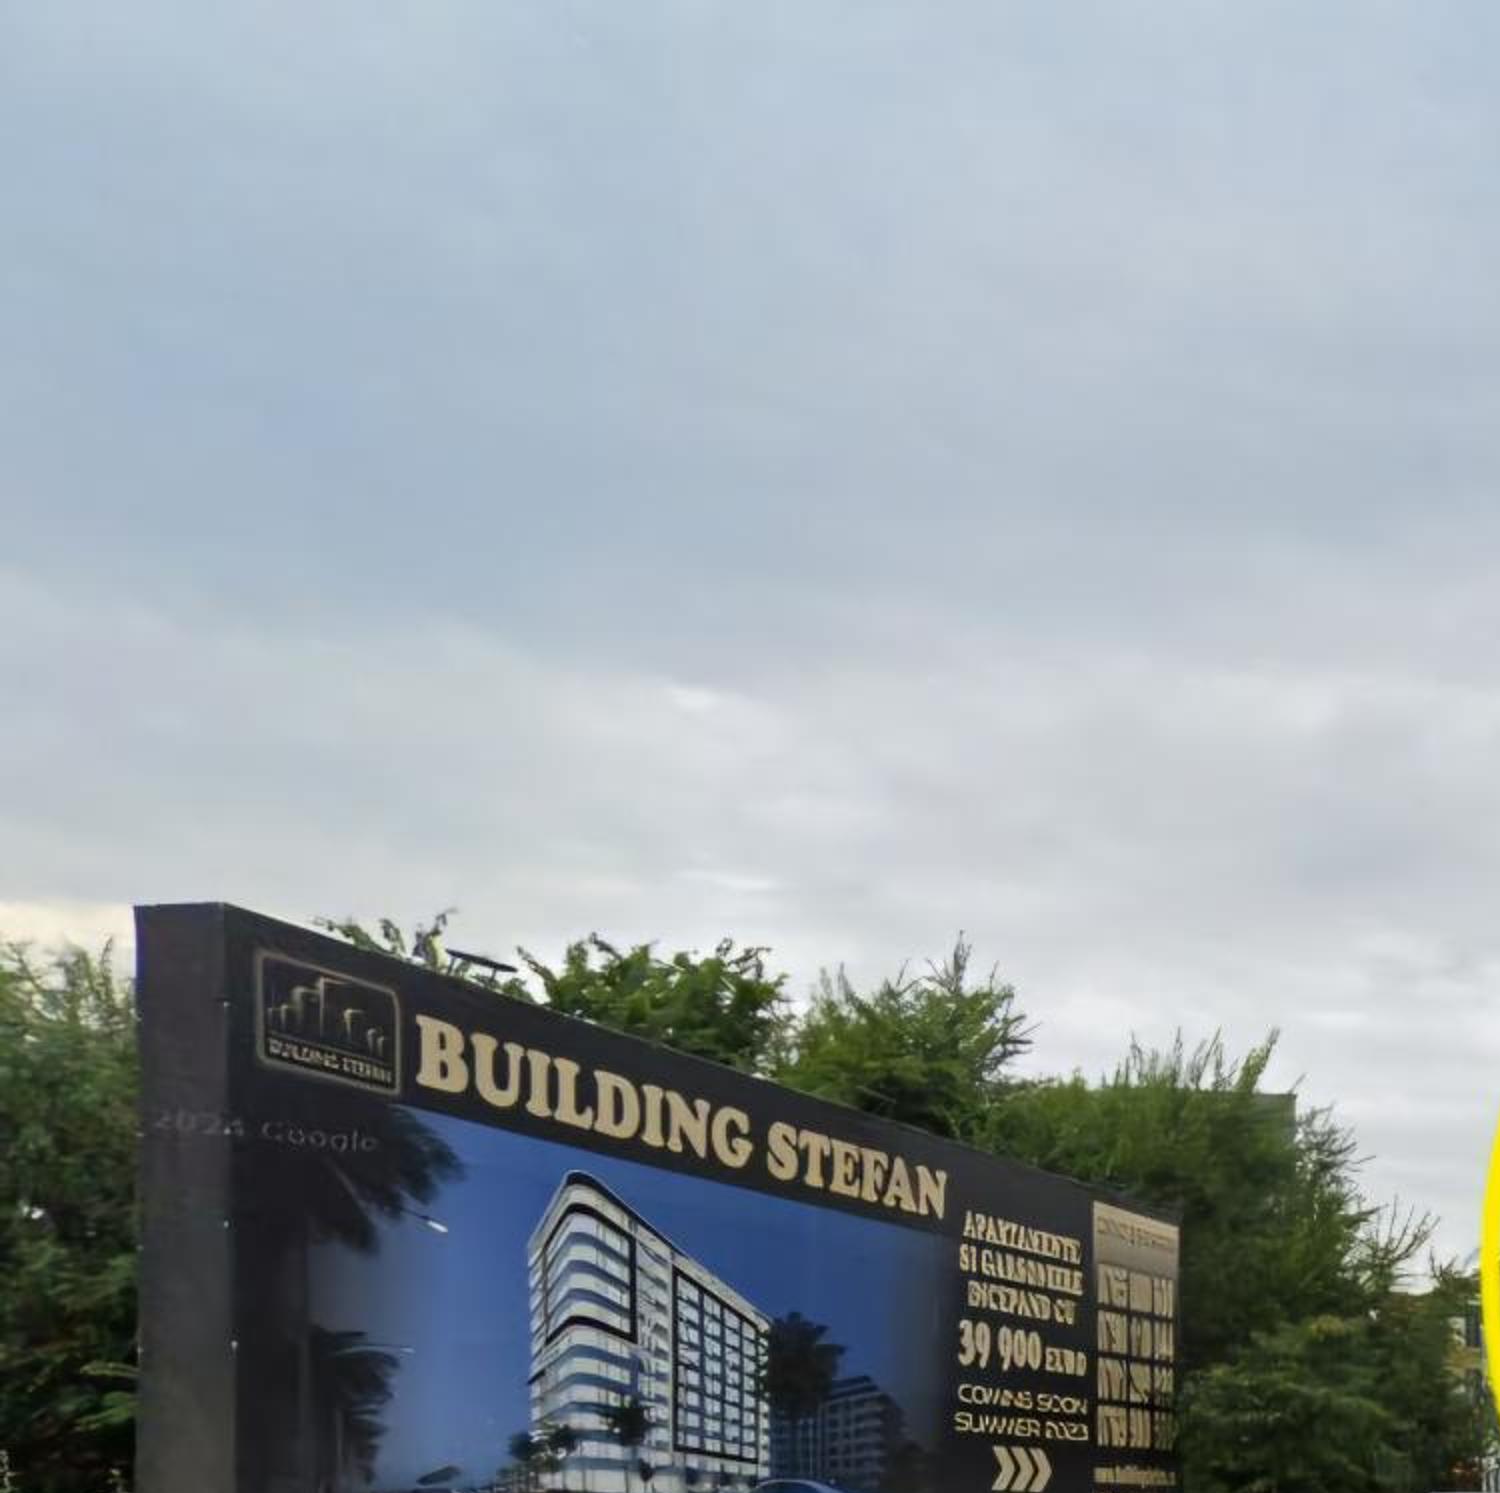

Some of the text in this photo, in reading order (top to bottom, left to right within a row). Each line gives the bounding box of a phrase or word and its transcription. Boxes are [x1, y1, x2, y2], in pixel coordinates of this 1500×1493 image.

[416, 1014, 947, 1219] BUILDING STEFAN
[958, 1319, 991, 1369] 39
[998, 1325, 1042, 1371] 900
[1037, 1393, 1087, 1415] SOON
[954, 1411, 1040, 1437] SUMMER
